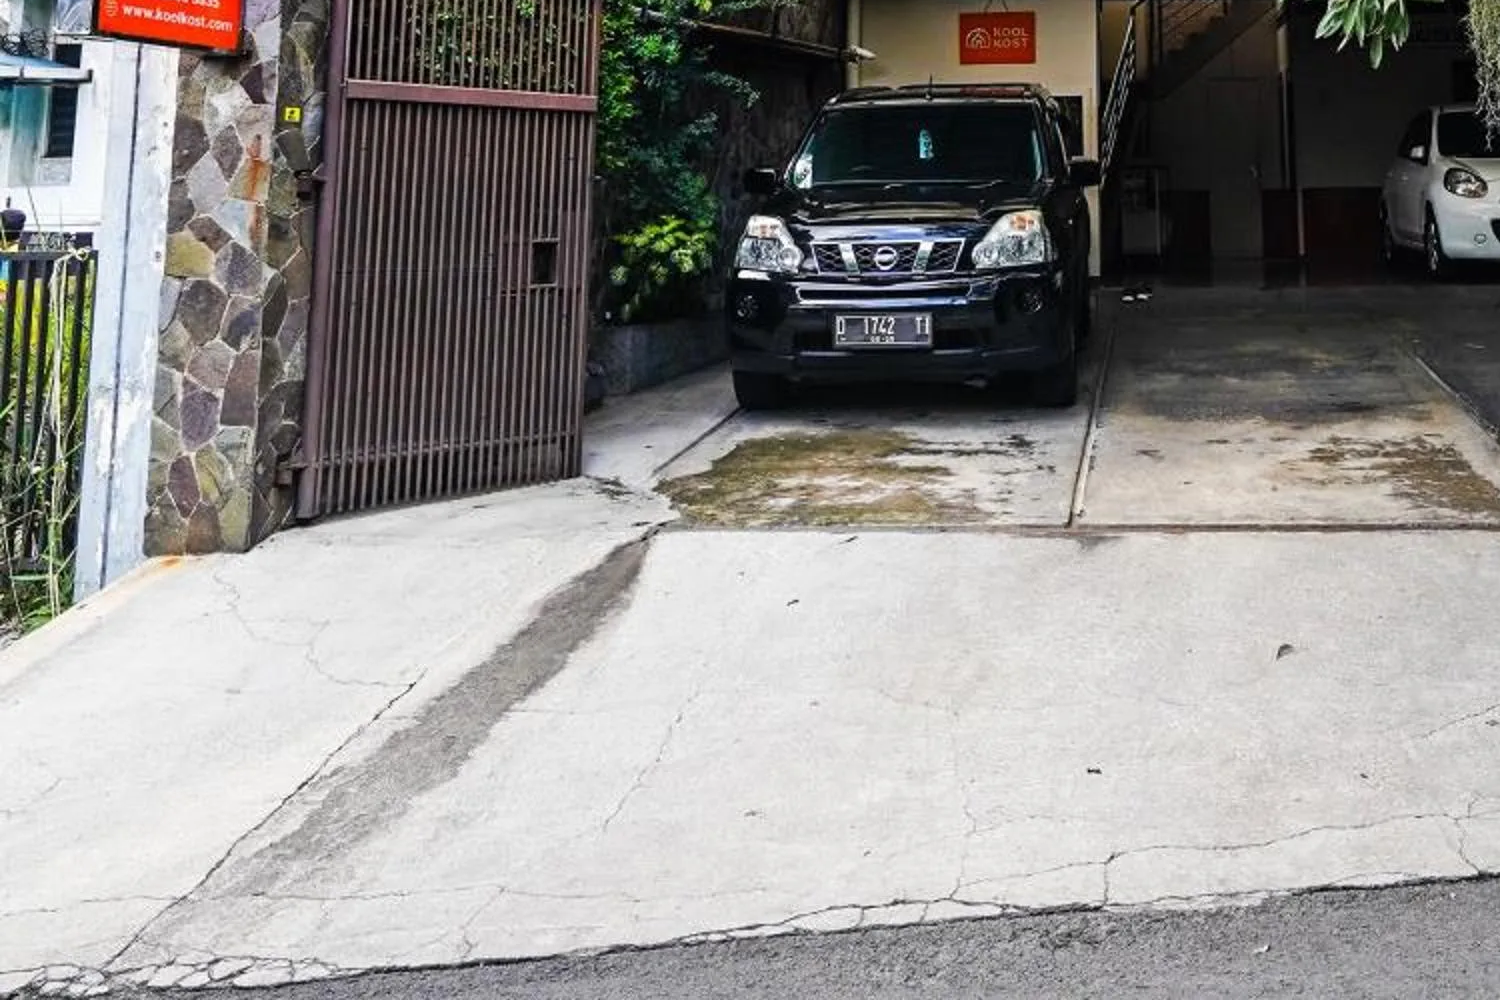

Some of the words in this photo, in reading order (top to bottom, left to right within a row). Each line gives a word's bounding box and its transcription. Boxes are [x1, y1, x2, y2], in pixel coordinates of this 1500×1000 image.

[122, 4, 233, 32] www.koolkost.com
[993, 27, 1029, 37] KOOL
[993, 37, 1029, 49] KOST
[864, 316, 895, 335] 1742
